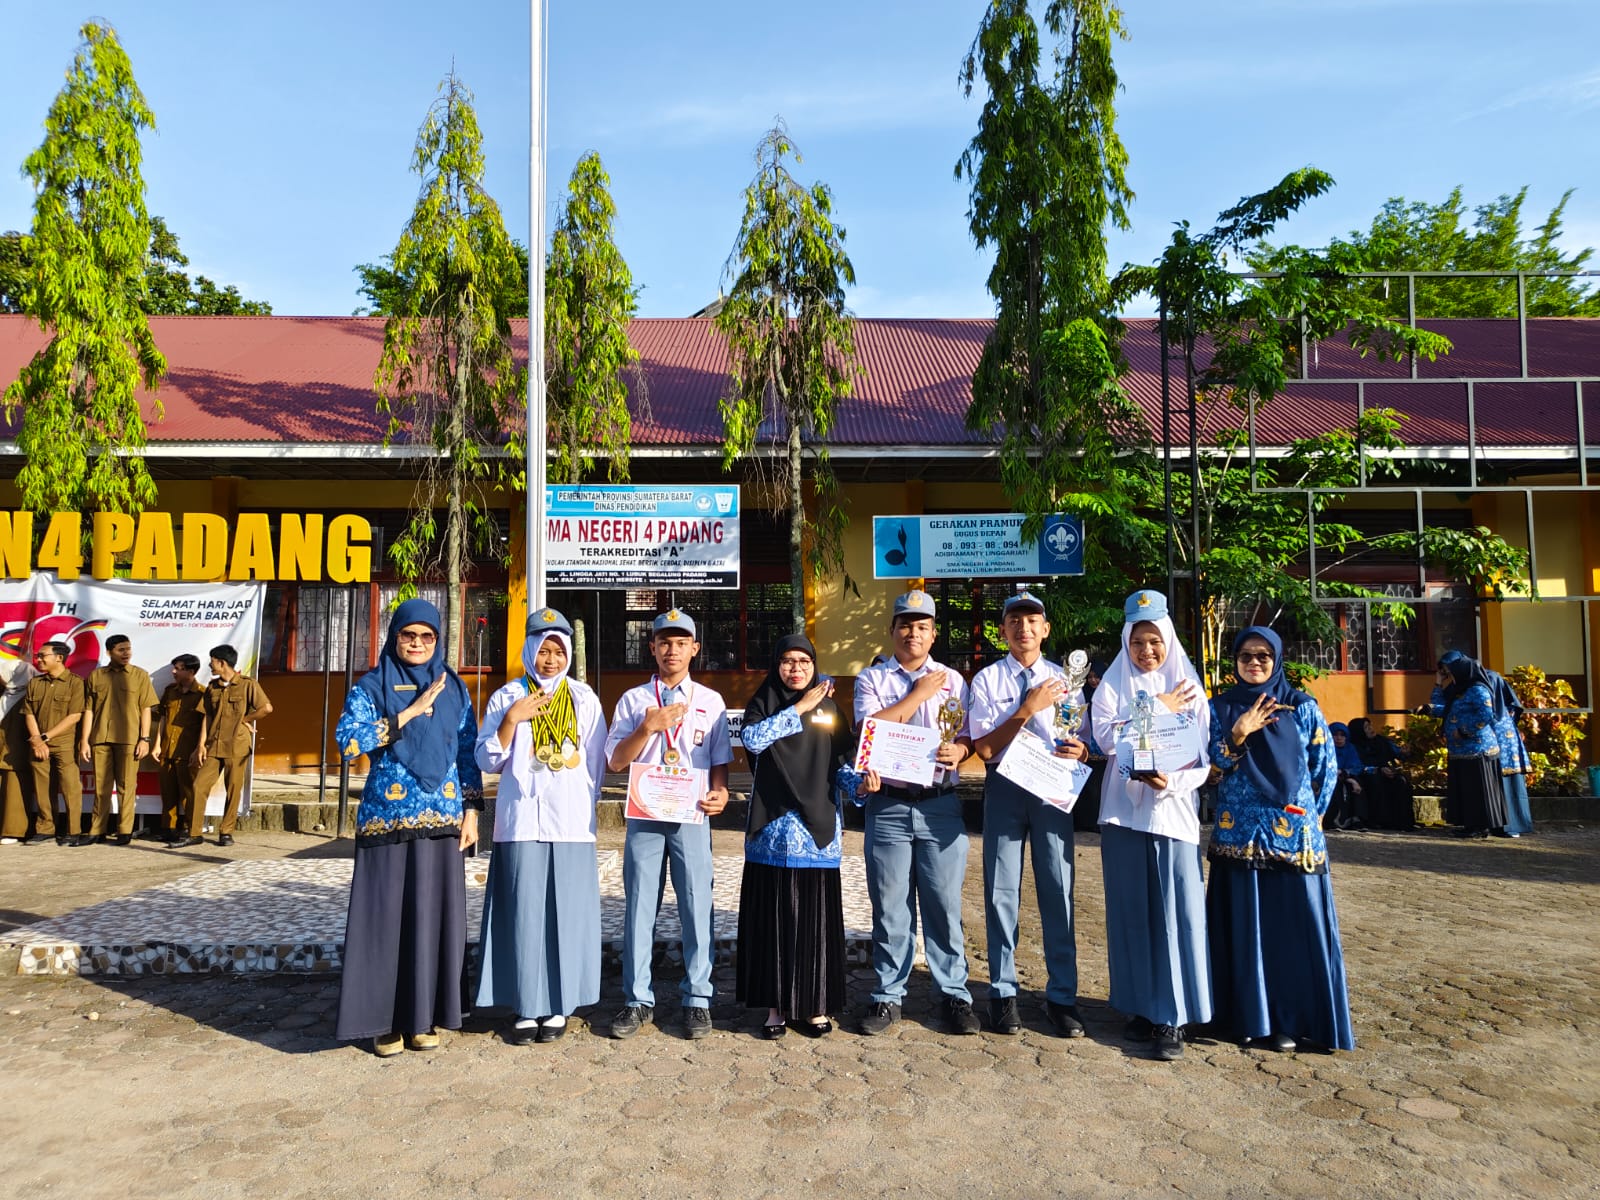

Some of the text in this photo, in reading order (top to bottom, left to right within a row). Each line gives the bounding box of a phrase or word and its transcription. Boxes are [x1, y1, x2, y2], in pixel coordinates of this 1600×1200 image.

[558, 492, 692, 501] PEMERINTAH PROVINSI SUMATERA BARAT
[594, 502, 656, 511] DINAS PENDIDIKAN
[929, 519, 1024, 529] GERAKAN PRAMUK
[546, 519, 724, 544] MA NEGERI 4 PADANG
[954, 530, 979, 538] GUGUS
[38, 511, 83, 580] 4
[92, 511, 372, 584] PADANG
[942, 542, 953, 550] 08
[960, 541, 976, 549] 093
[985, 541, 995, 549] 08
[580, 547, 661, 557] TERAKREDITASI
[57, 602, 77, 615] TH
[141, 599, 252, 609] SELAMAT HARI JAD
[139, 610, 245, 620] SUMATERA BARAT
